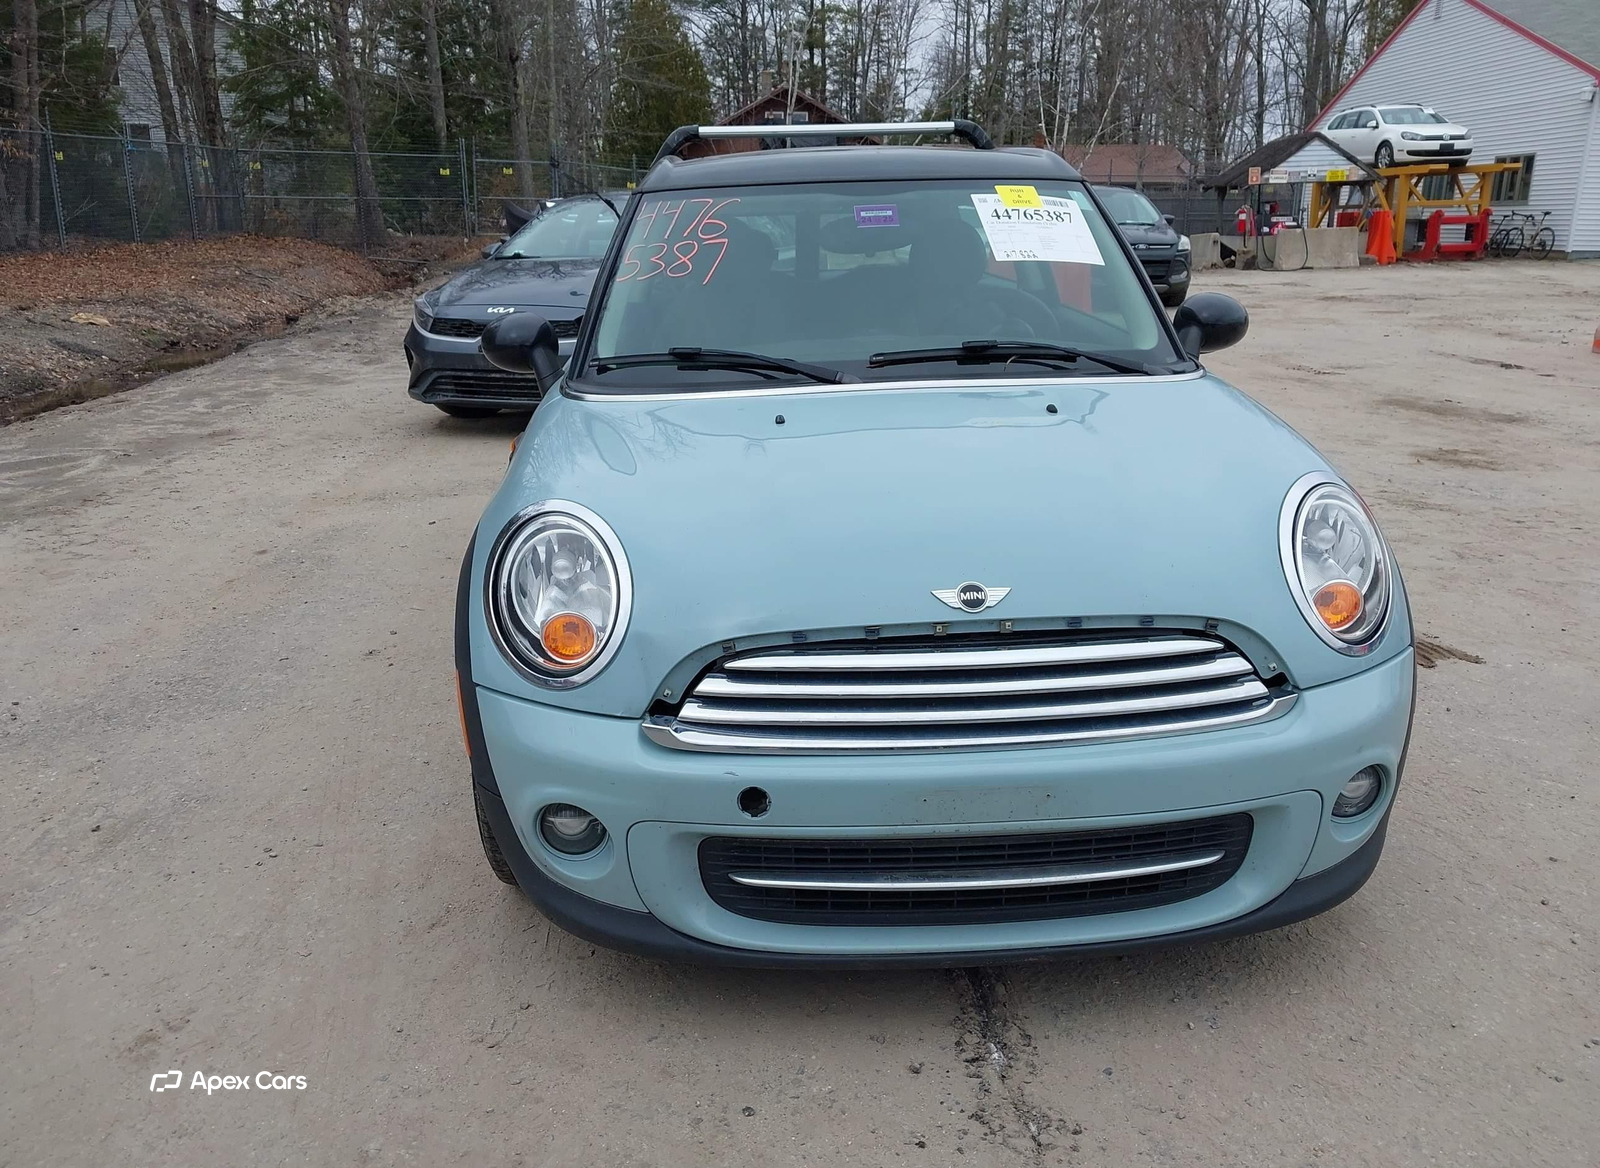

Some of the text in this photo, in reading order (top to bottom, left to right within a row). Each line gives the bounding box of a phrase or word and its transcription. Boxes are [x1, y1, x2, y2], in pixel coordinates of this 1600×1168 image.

[637, 198, 741, 239] 4476
[990, 208, 1072, 223] 44765387
[616, 238, 729, 285] 5387
[960, 591, 985, 601] MINI
